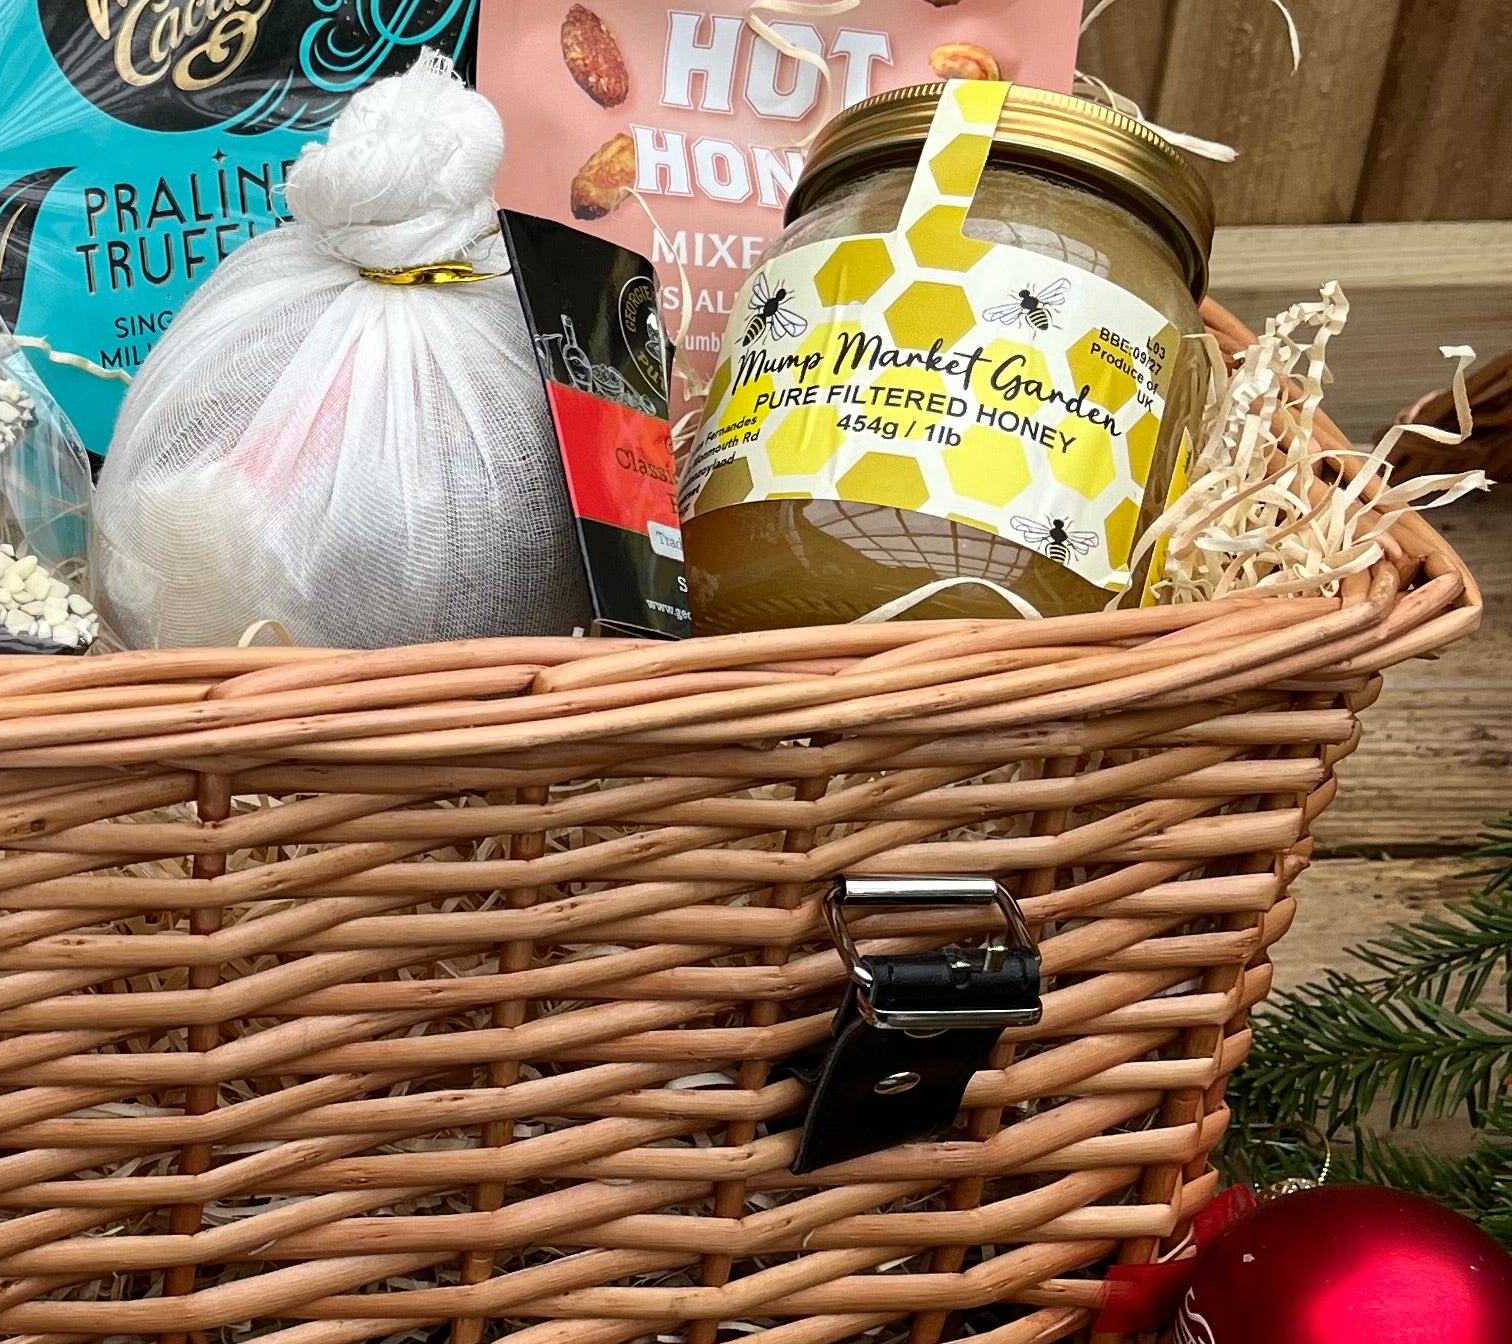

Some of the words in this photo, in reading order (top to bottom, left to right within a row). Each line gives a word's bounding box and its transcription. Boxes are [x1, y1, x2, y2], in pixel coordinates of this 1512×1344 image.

[660, 9, 895, 121] HOT
[629, 123, 808, 212] HON
[652, 227, 766, 270] MIXE
[623, 284, 654, 334] GEORGIE
[1090, 341, 1145, 384] Produce
[1146, 378, 1159, 395] of
[1099, 326, 1163, 376] BBE:09/27
[1146, 336, 1167, 360] L03
[733, 346, 824, 396] Mump
[831, 330, 980, 392] Market
[992, 354, 1124, 439] Garden
[1137, 389, 1155, 413] UK
[742, 427, 761, 445] Rd
[753, 383, 820, 414] PURE
[829, 383, 968, 420] FILTERED
[976, 402, 1077, 455] HONEY
[835, 413, 898, 444] 454g
[923, 420, 962, 448] 1lb
